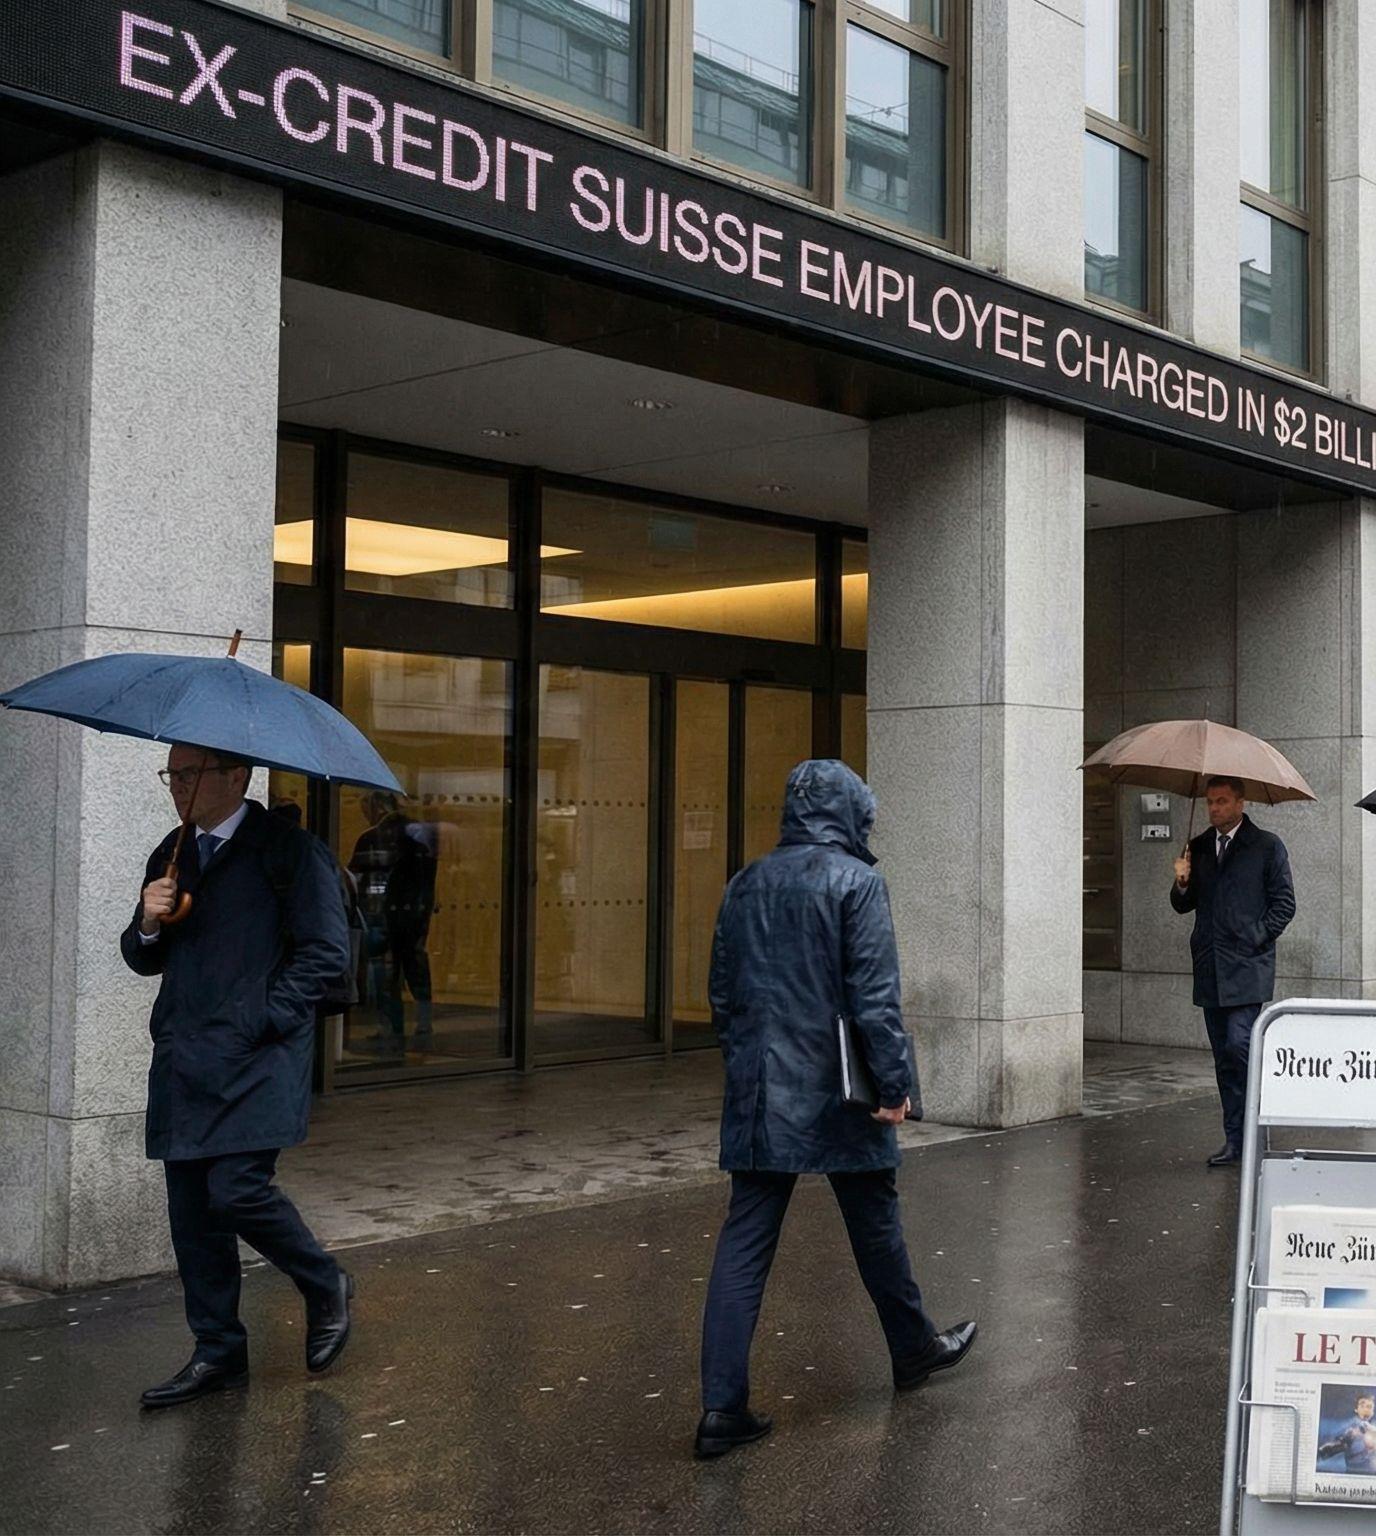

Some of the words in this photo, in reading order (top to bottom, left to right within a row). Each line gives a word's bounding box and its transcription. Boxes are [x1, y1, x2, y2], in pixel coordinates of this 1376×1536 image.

[121, 11, 554, 212] EX-CREDIT
[570, 166, 784, 288] SUISSE
[800, 239, 1046, 368] EMPLOYEE
[1056, 327, 1229, 423] CHARGED
[1237, 386, 1267, 437] IN
[1273, 397, 1307, 450] $2
[1273, 1047, 1332, 1079] Neue
[1285, 1233, 1336, 1259] Neue
[1292, 1333, 1341, 1365] LE
